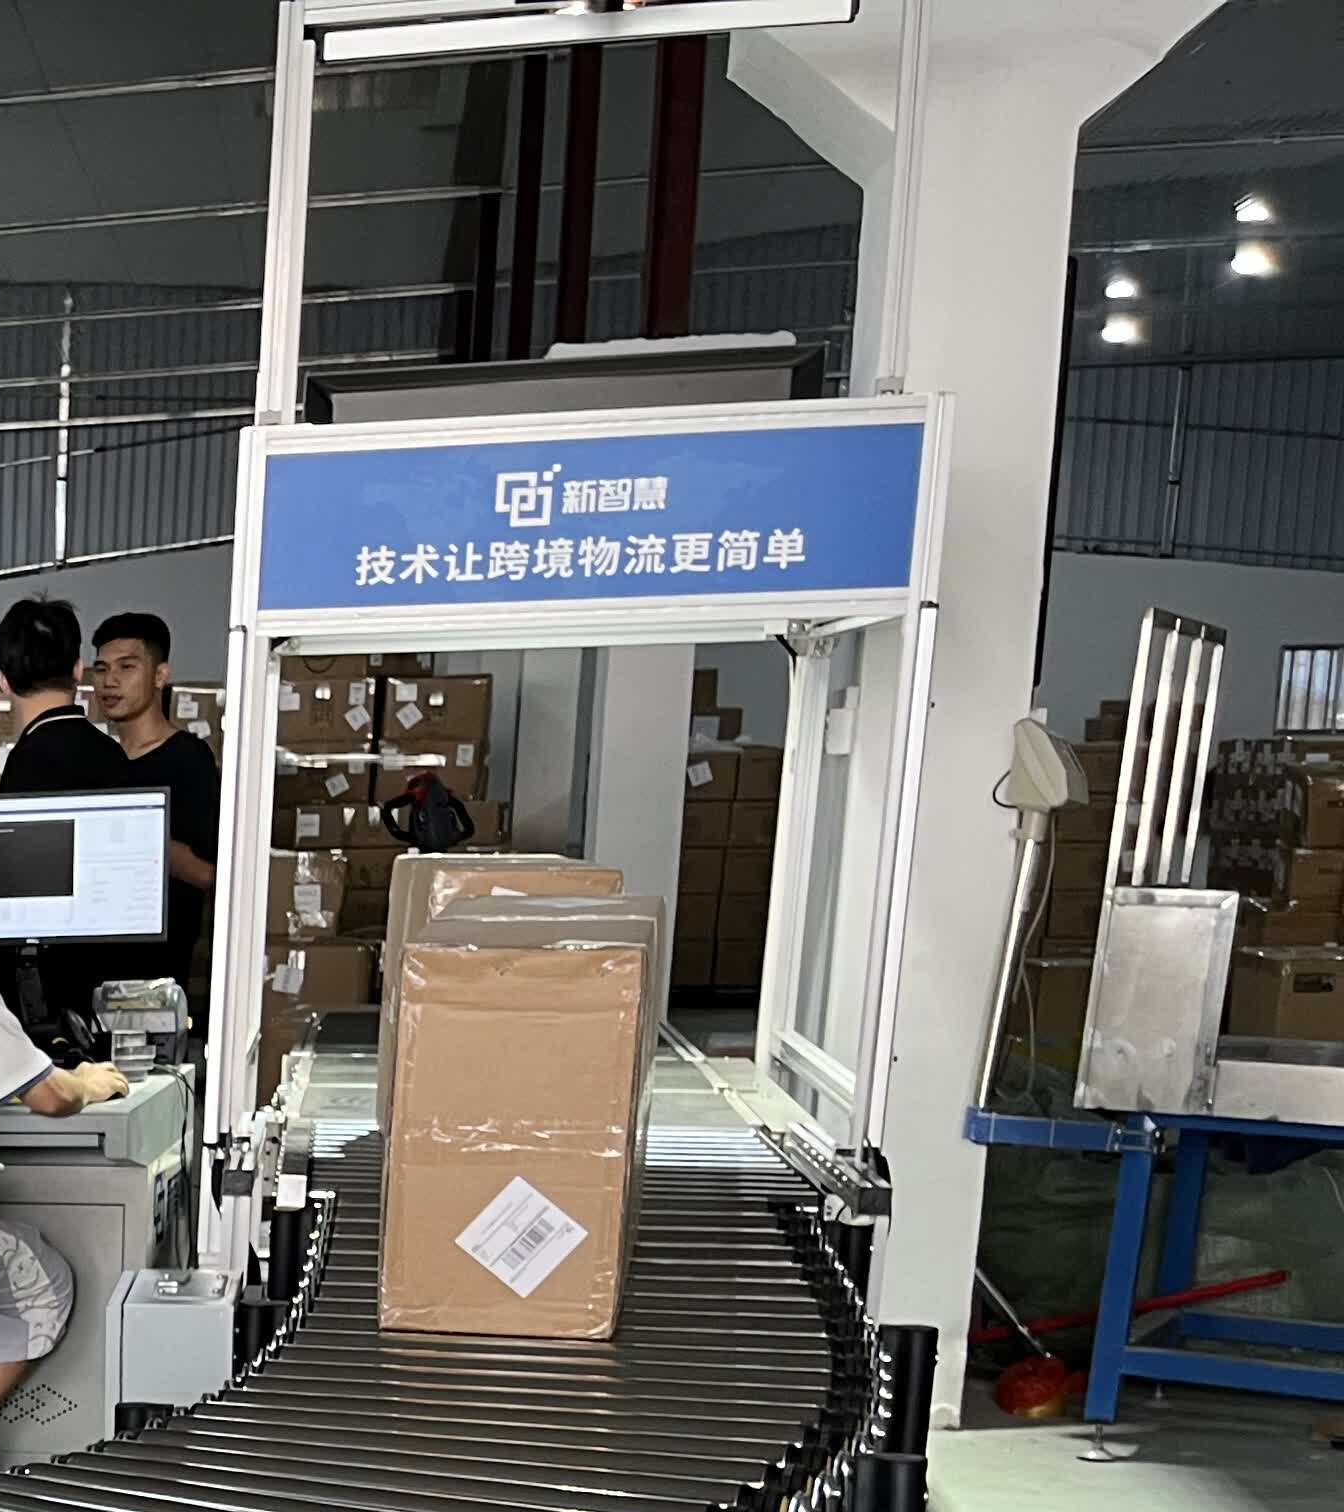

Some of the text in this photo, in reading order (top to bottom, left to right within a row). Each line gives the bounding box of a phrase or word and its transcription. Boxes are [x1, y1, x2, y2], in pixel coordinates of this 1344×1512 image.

[561, 476, 670, 514] 新智慧
[355, 528, 807, 588] 技术让跨境物流更简单
